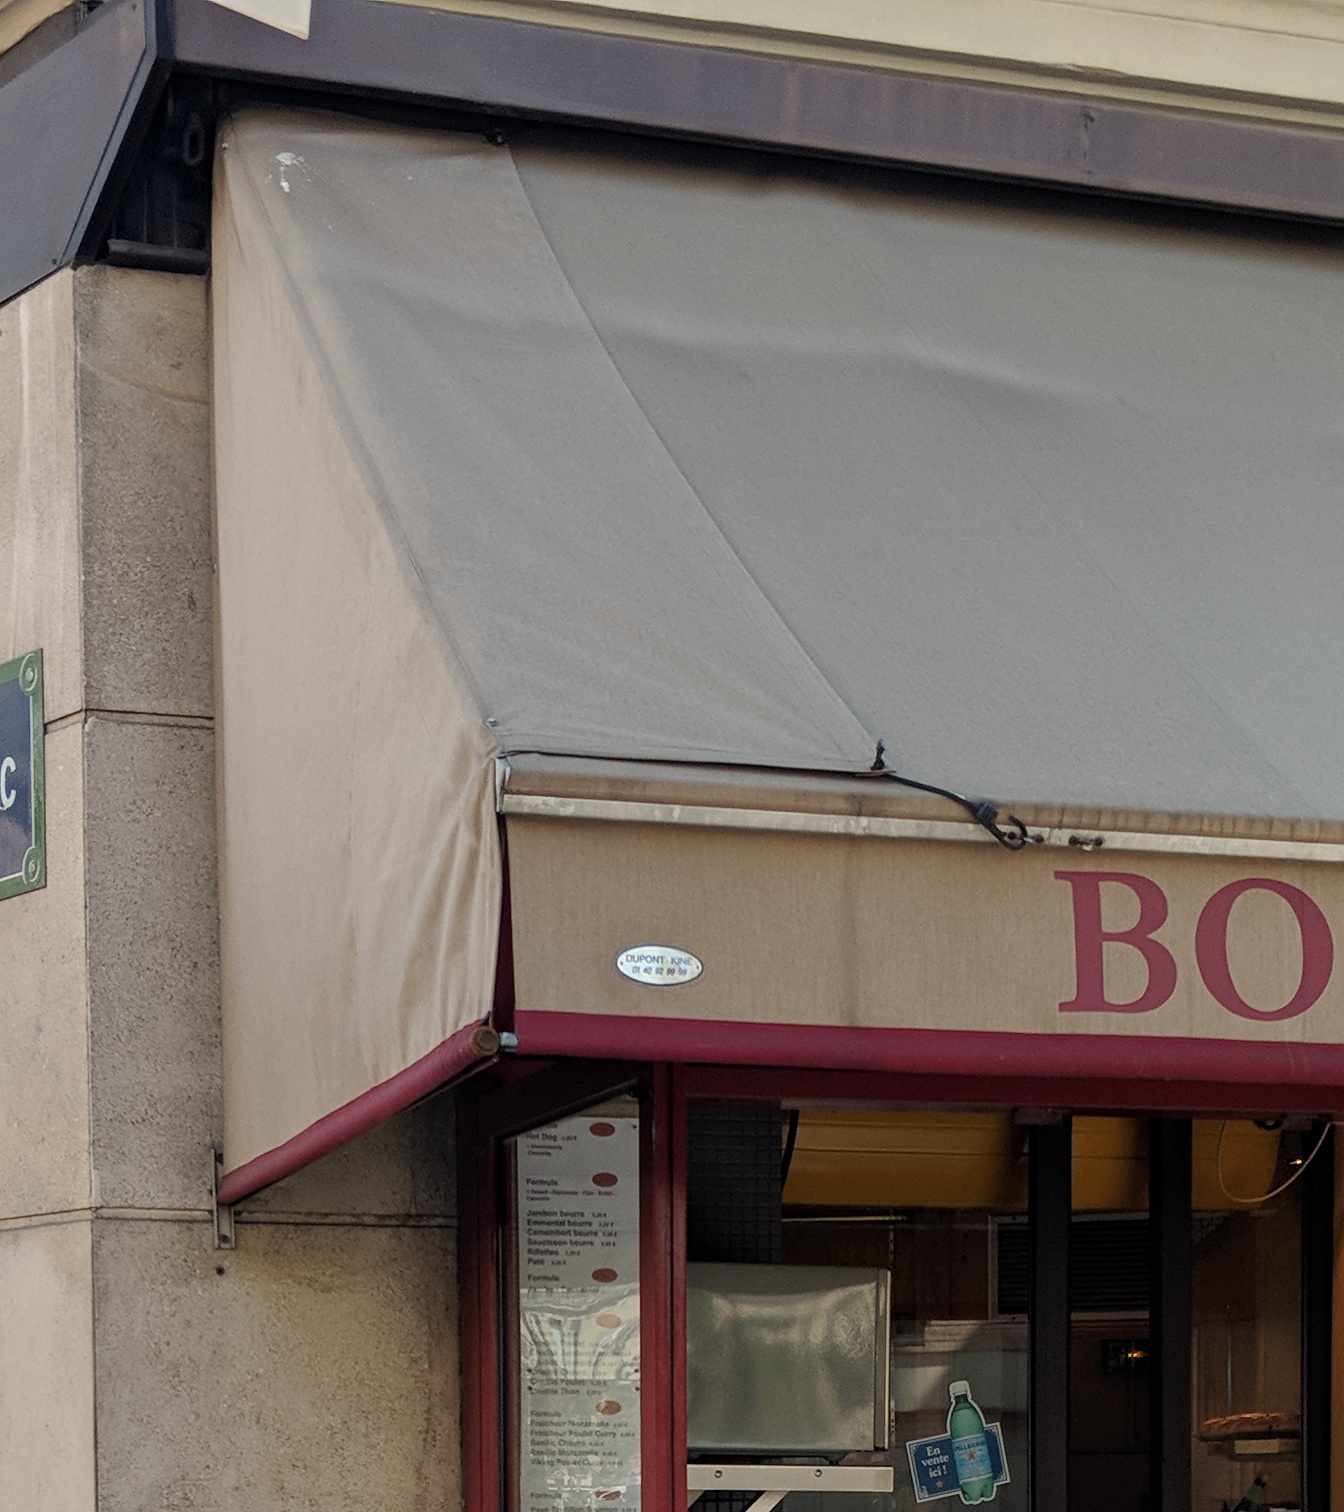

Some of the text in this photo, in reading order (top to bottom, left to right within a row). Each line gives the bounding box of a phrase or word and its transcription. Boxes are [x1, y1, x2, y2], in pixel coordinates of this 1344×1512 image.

[625, 954, 665, 964] DUPONT
[526, 1209, 558, 1218] Jambon
[526, 1219, 566, 1227] Emmental
[526, 1229, 572, 1237] Camembert
[926, 1446, 941, 1457] En
[921, 1455, 950, 1466] vente
